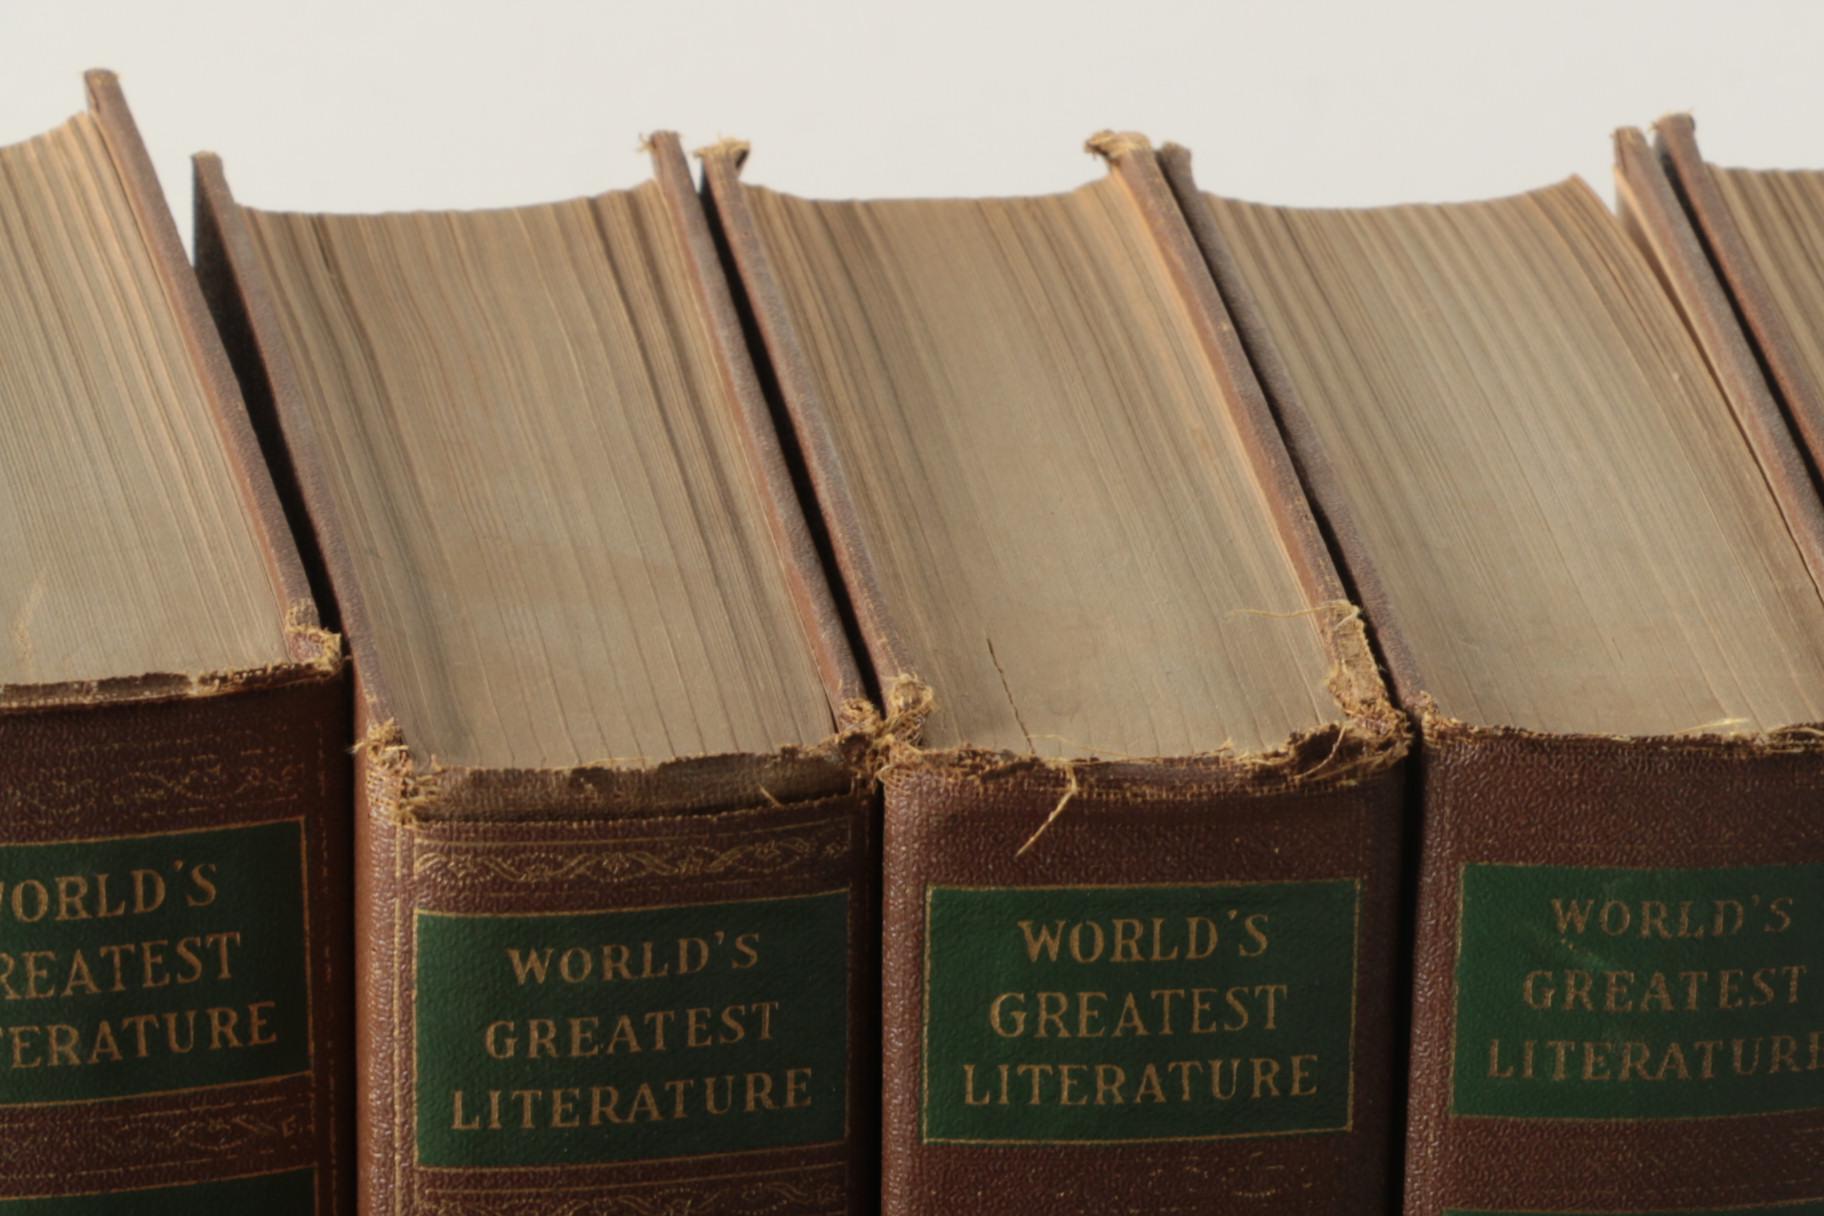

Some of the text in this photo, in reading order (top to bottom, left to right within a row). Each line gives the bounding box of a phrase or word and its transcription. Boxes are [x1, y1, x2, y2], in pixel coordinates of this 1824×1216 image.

[0, 859, 219, 923] ORLD'S
[1552, 894, 1794, 940] WORLD'S
[505, 930, 761, 986] WORLD'S
[1017, 909, 1270, 964] WORLD'S
[990, 983, 1288, 1039] GREATEST
[1522, 964, 1808, 1013] GREATEST
[0, 1000, 278, 1070] ERATURE
[485, 1001, 780, 1060] GREATEST
[450, 1066, 814, 1131] LITERATURE
[962, 1054, 1319, 1106] LITERATURE
